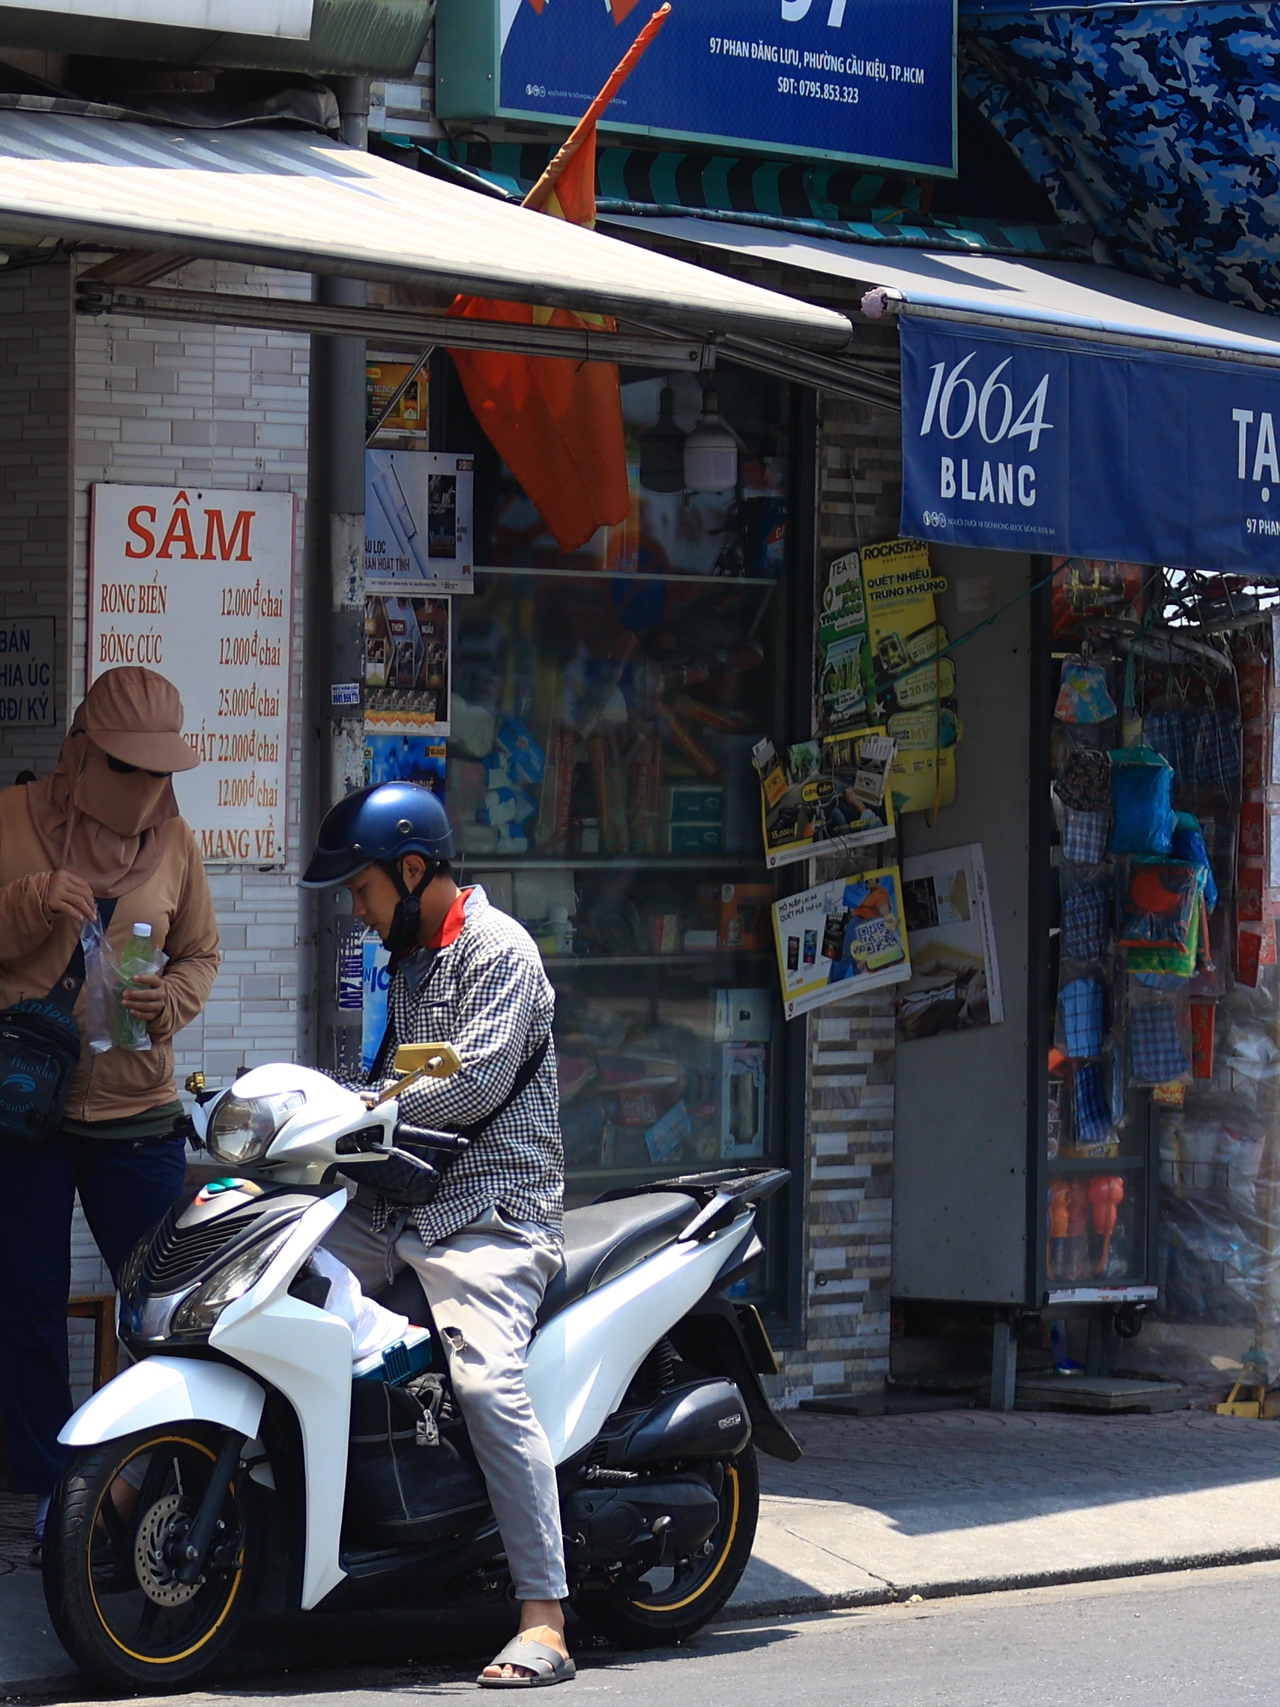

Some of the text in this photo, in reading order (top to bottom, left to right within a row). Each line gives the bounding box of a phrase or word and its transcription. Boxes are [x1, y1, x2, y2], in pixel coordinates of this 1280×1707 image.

[709, 37, 721, 54] 97
[723, 38, 749, 58] PHAN
[751, 40, 778, 62] ĐĂNG
[780, 47, 802, 69] LƯU,
[803, 50, 845, 73] PHƯỜNG
[846, 53, 864, 76] CẦU
[890, 64, 925, 84] TP.HCM
[777, 76, 859, 104] SĐT: 0795.853.323
[920, 351, 1054, 452] 1664
[940, 456, 1036, 507] BLANC
[124, 490, 256, 561] SÂM
[1246, 518, 1257, 533] 97
[864, 541, 928, 560] ROCKSTAR
[100, 569, 283, 620] RONG BIỂN 12.000đ/chai
[867, 575, 894, 588] QUÉT
[99, 625, 281, 669] BÔNG CÚC 12.000đ/chai
[28, 656, 50, 687] ÚC
[27, 690, 49, 720] KÝ
[217, 682, 280, 720] 25.000đ/chai
[217, 729, 279, 765] 22.000đ/chai
[217, 771, 278, 810] 12.000đ/chai
[200, 814, 276, 859] MANG VỀ
